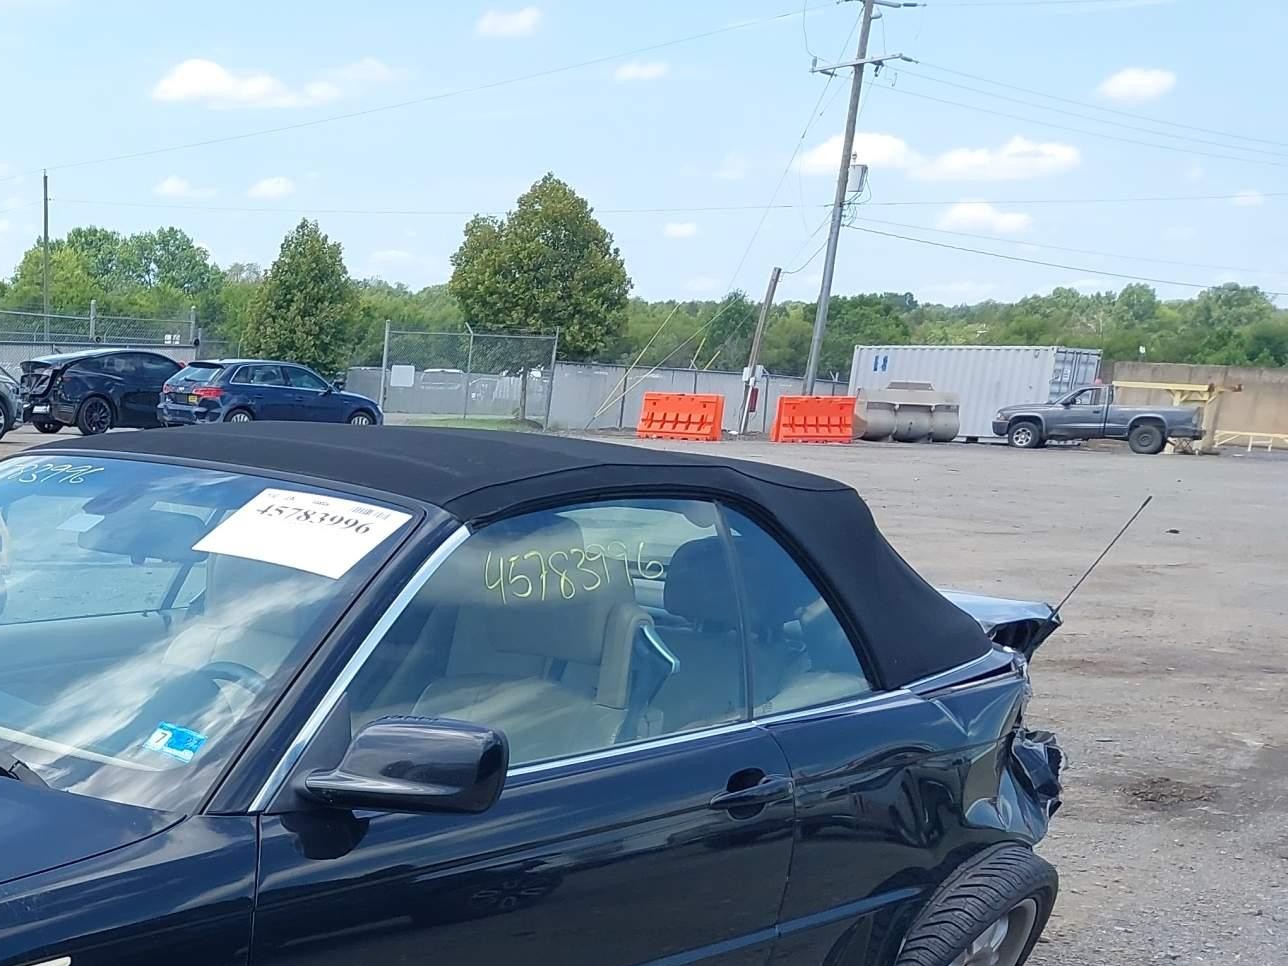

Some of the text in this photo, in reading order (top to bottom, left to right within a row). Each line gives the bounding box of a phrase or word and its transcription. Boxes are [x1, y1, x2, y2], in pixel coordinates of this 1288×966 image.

[255, 503, 376, 535] 45783996
[484, 541, 664, 604] 45783996
[154, 732, 169, 744] 7
